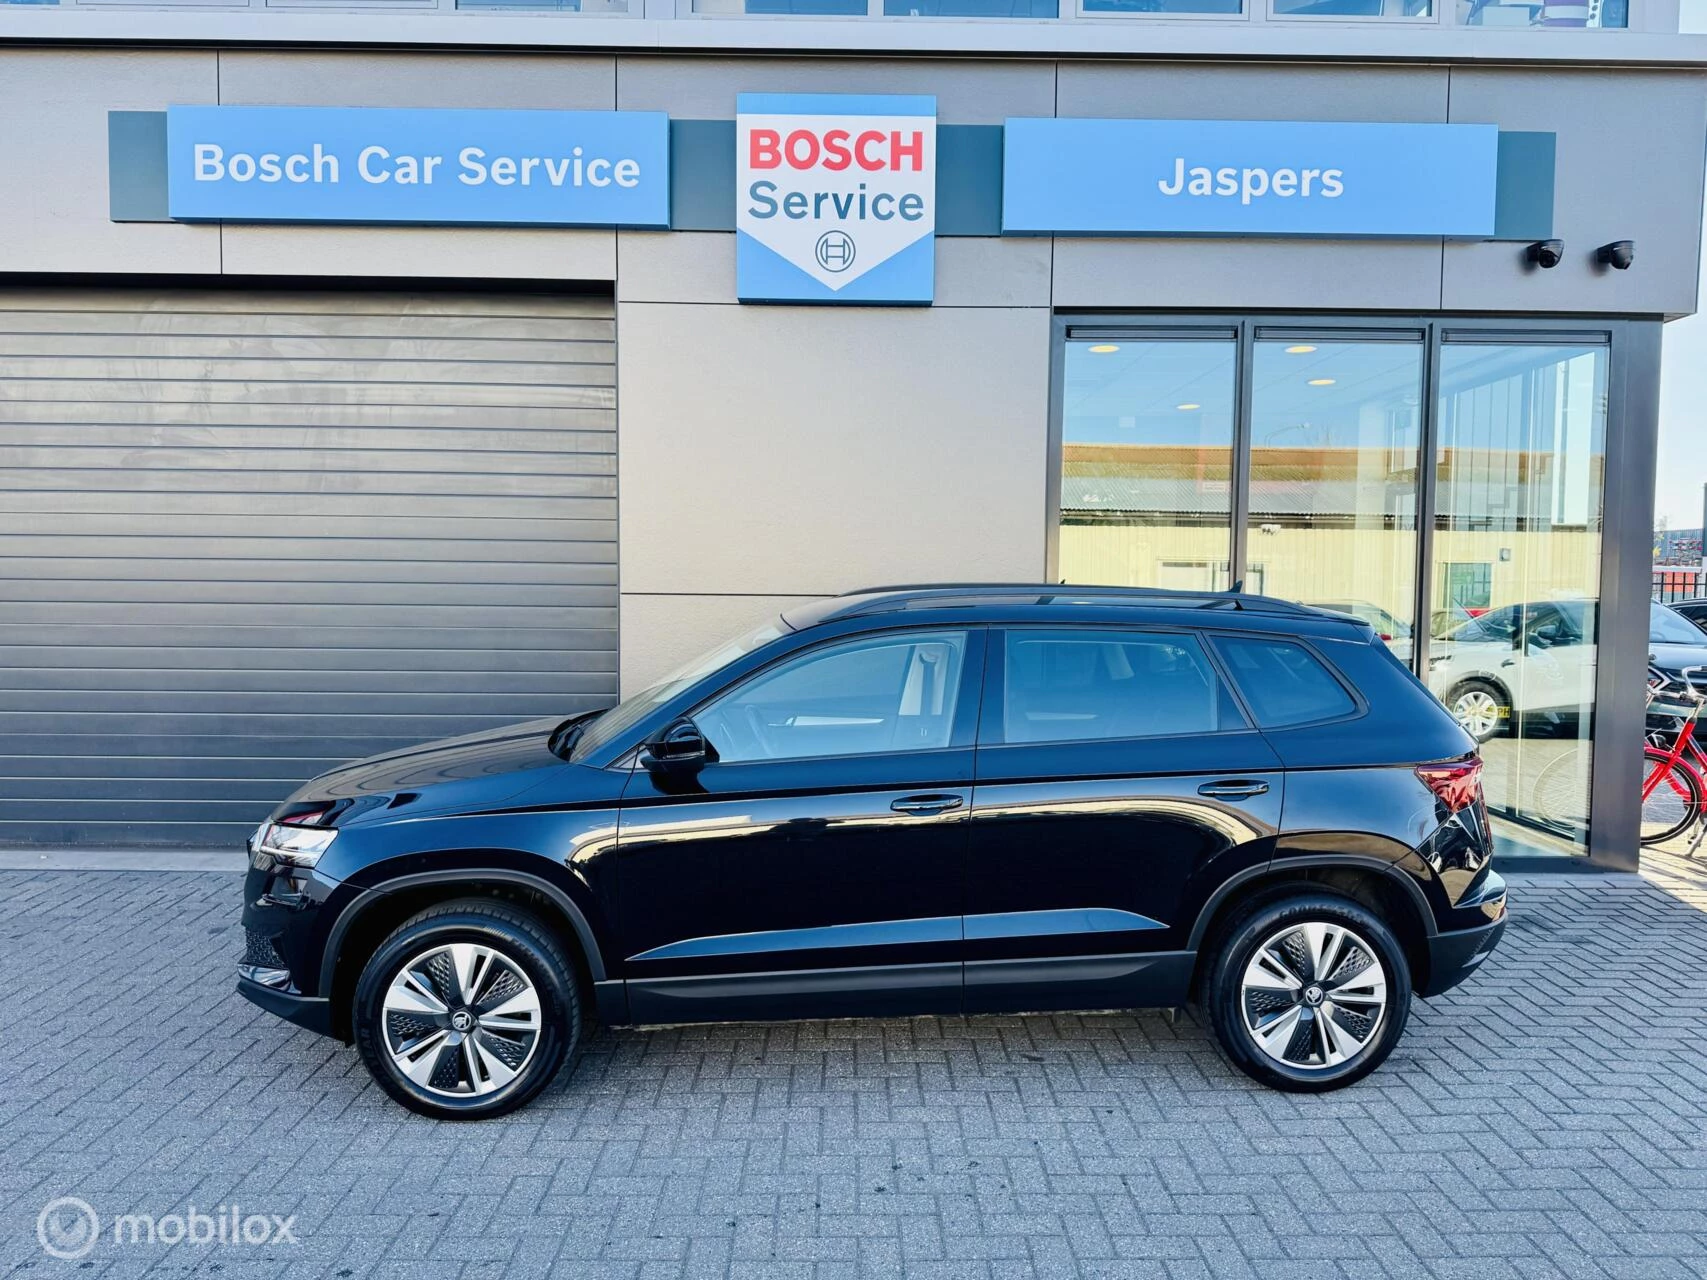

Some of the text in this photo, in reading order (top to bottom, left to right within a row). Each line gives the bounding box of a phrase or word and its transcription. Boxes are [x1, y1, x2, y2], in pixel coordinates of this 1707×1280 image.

[193, 143, 641, 188] Bosch Car Service
[749, 128, 923, 172] BOSCH
[748, 180, 924, 221] Service
[1157, 157, 1345, 206] Jaspers
